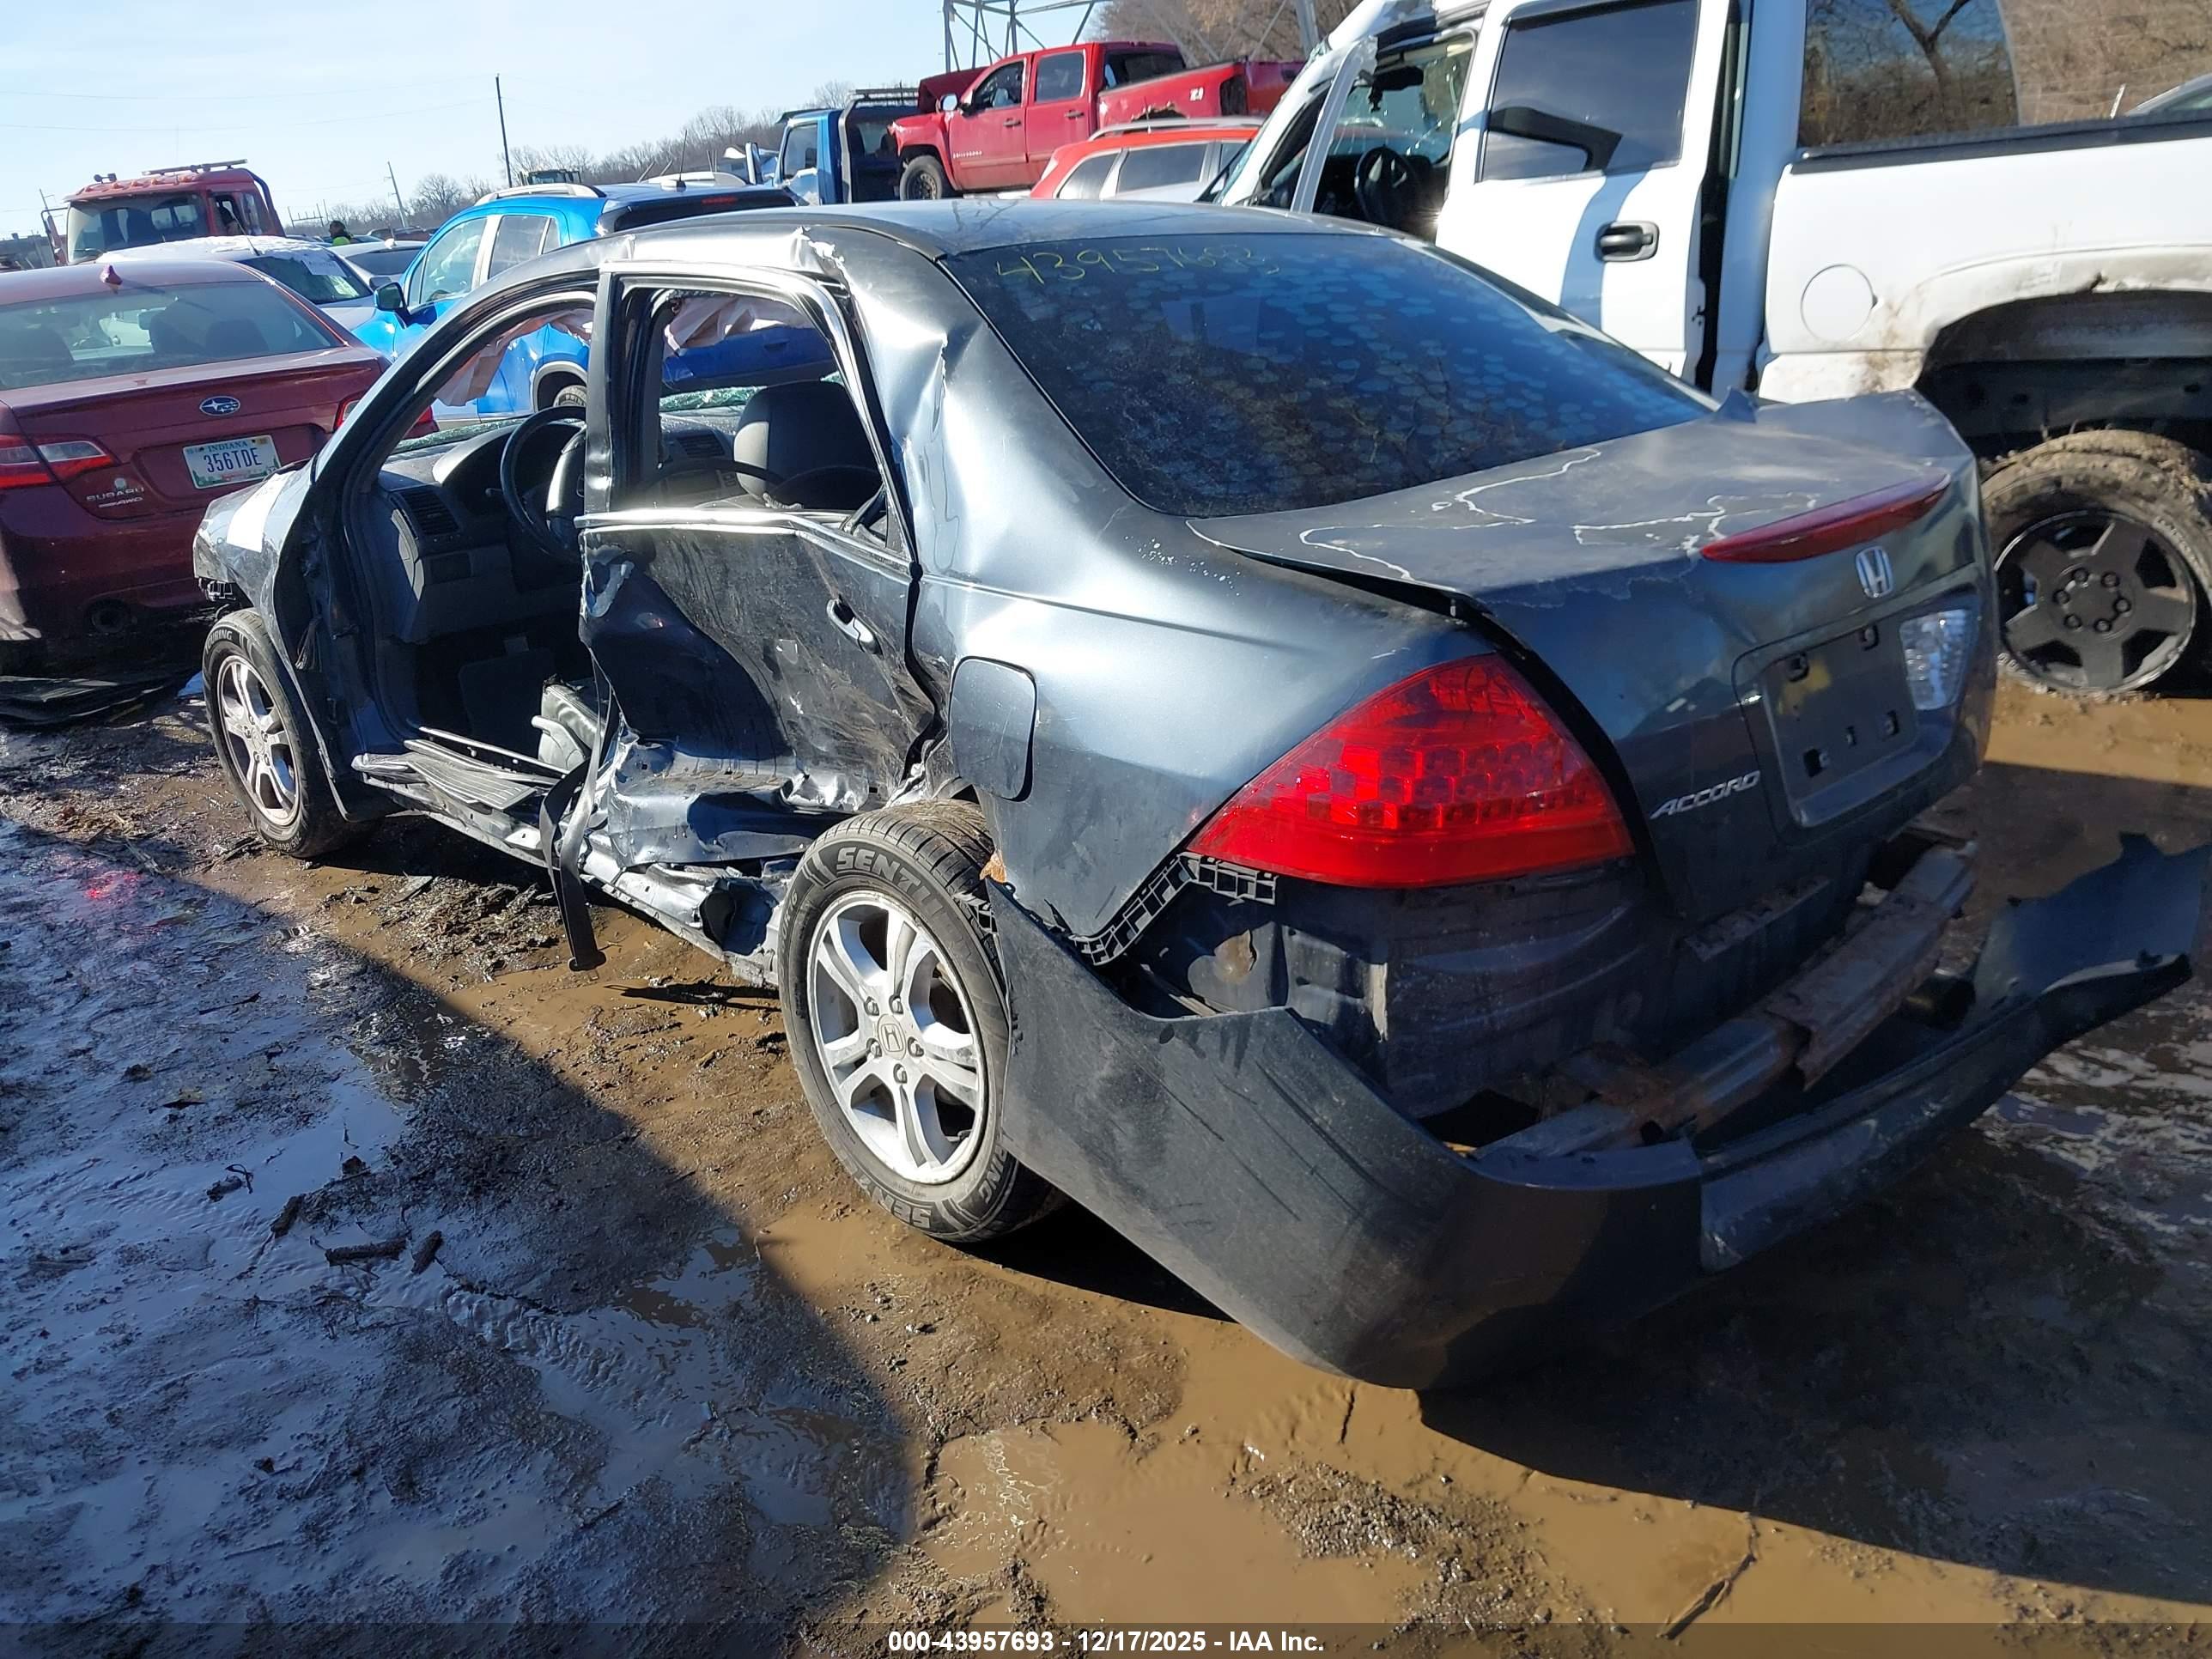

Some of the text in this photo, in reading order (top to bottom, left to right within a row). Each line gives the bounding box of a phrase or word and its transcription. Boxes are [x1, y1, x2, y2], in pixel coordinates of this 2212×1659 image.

[208, 441, 248, 453] INDIANA
[204, 447, 263, 473] 356TDE
[86, 486, 145, 501] SUBARU
[1650, 770, 1761, 819] ACCORD
